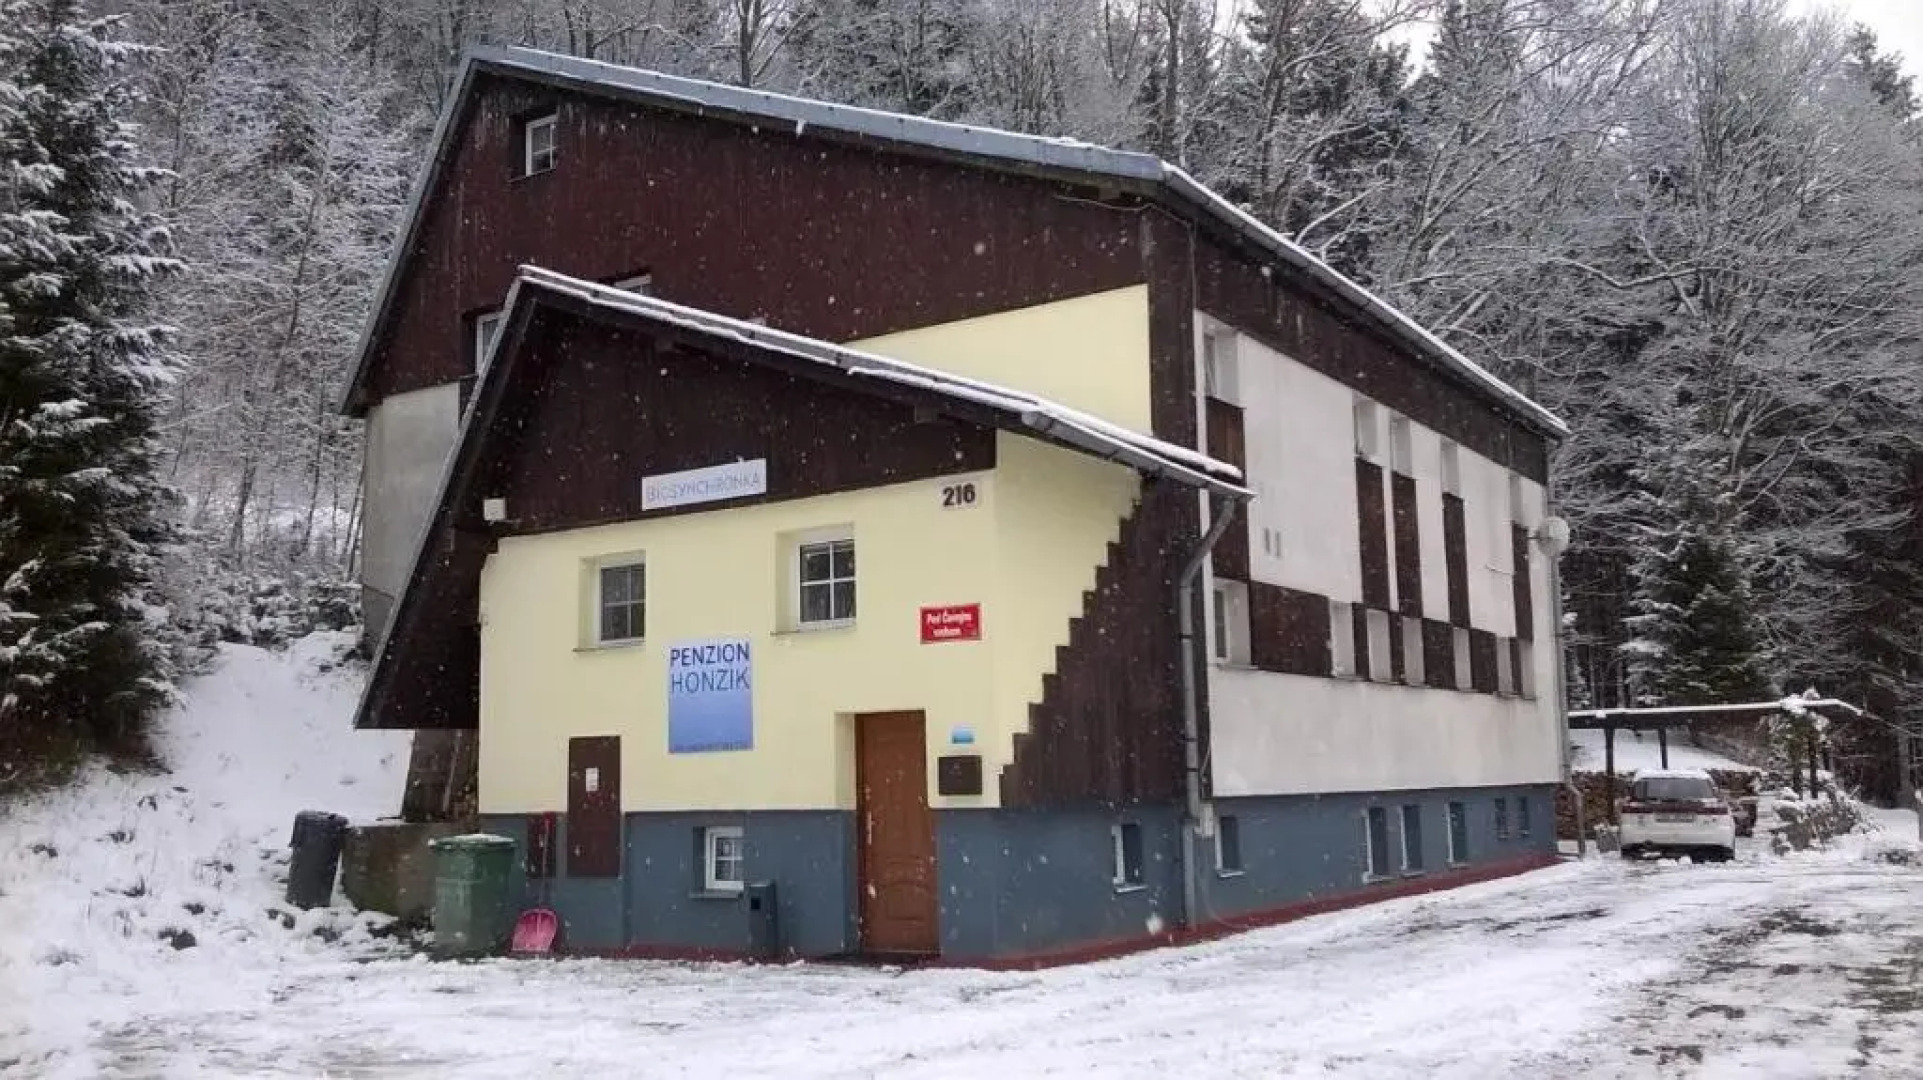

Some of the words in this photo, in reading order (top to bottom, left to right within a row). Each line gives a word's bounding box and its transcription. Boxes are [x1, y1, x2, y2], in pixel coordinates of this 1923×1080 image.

[943, 483, 975, 507] 216
[670, 642, 750, 667] PENZION
[671, 667, 750, 693] HONZIK
